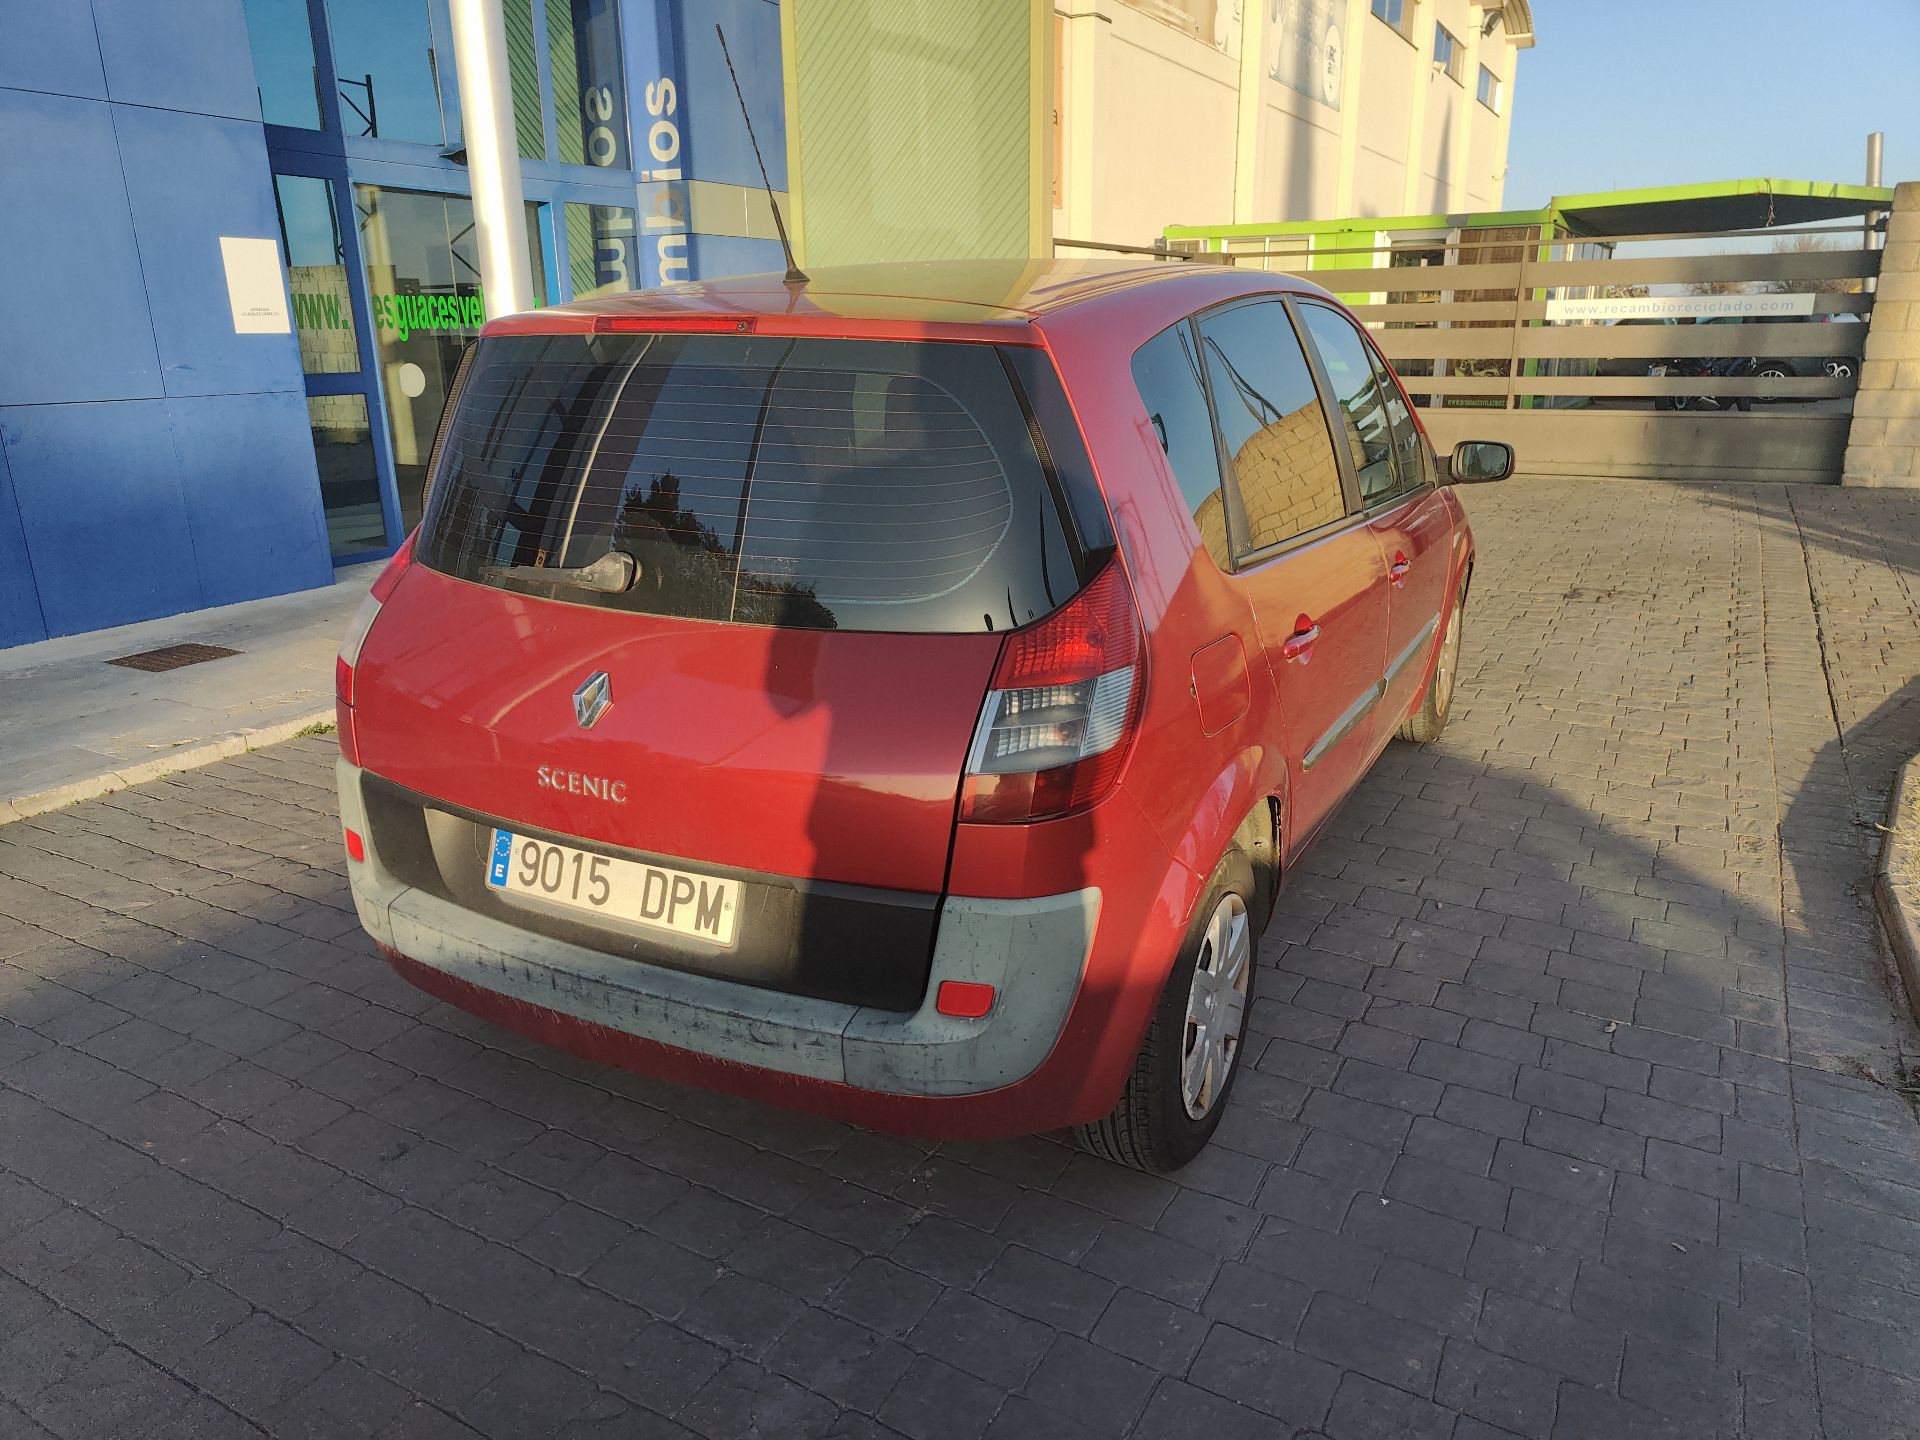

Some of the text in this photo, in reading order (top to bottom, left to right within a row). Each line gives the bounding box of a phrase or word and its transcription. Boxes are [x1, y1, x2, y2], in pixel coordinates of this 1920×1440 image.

[537, 765, 627, 804] SCENIC
[495, 863, 505, 878] E
[518, 840, 725, 936] 9015 DPM
